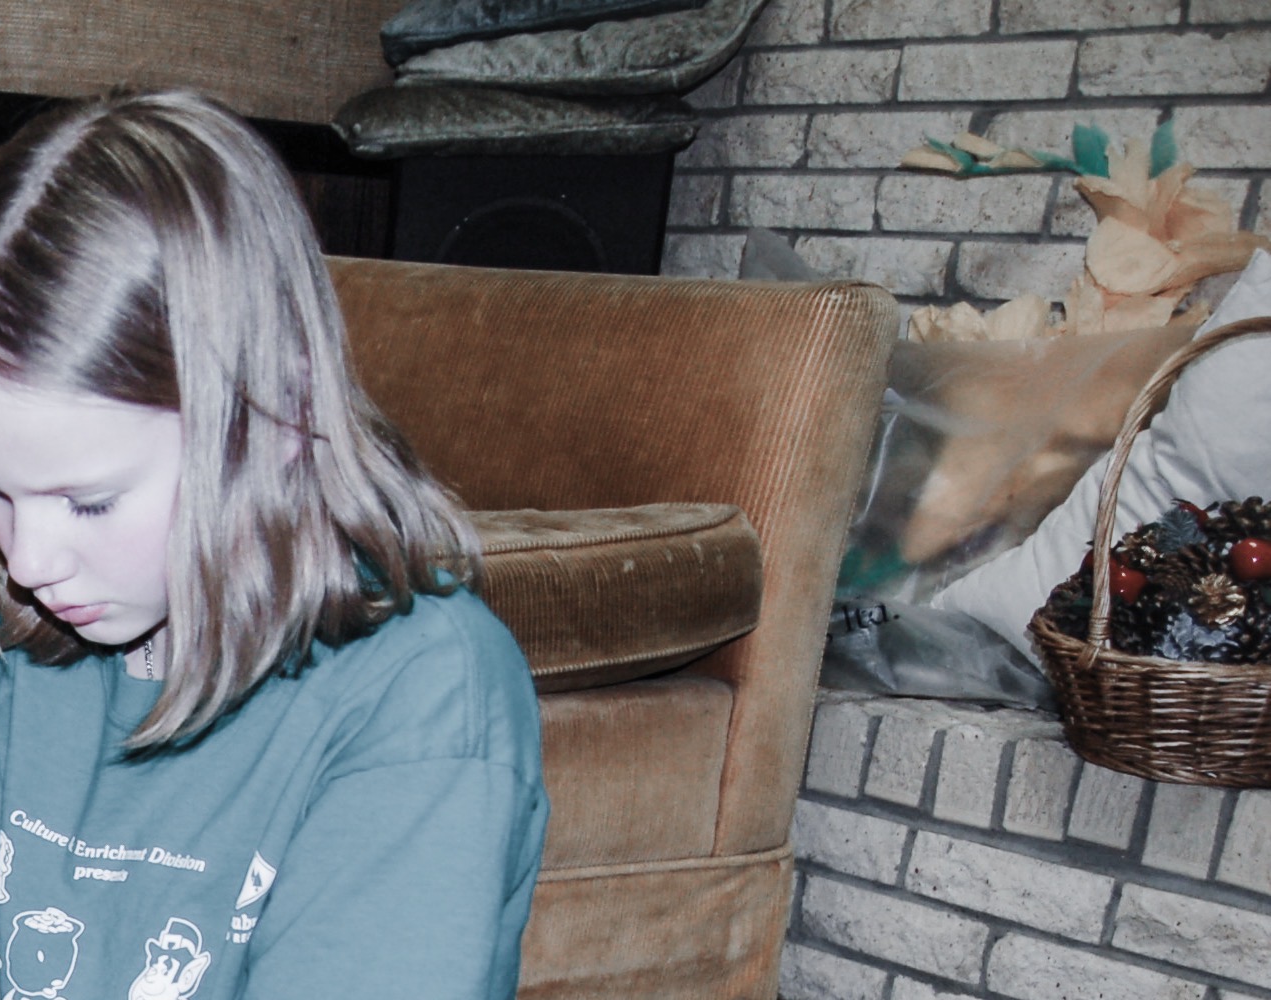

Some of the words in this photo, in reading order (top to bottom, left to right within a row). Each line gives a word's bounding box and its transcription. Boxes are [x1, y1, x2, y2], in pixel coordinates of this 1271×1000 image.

[10, 809, 69, 847] Culture
[74, 840, 147, 861] Enricht
[148, 846, 206, 872] Division
